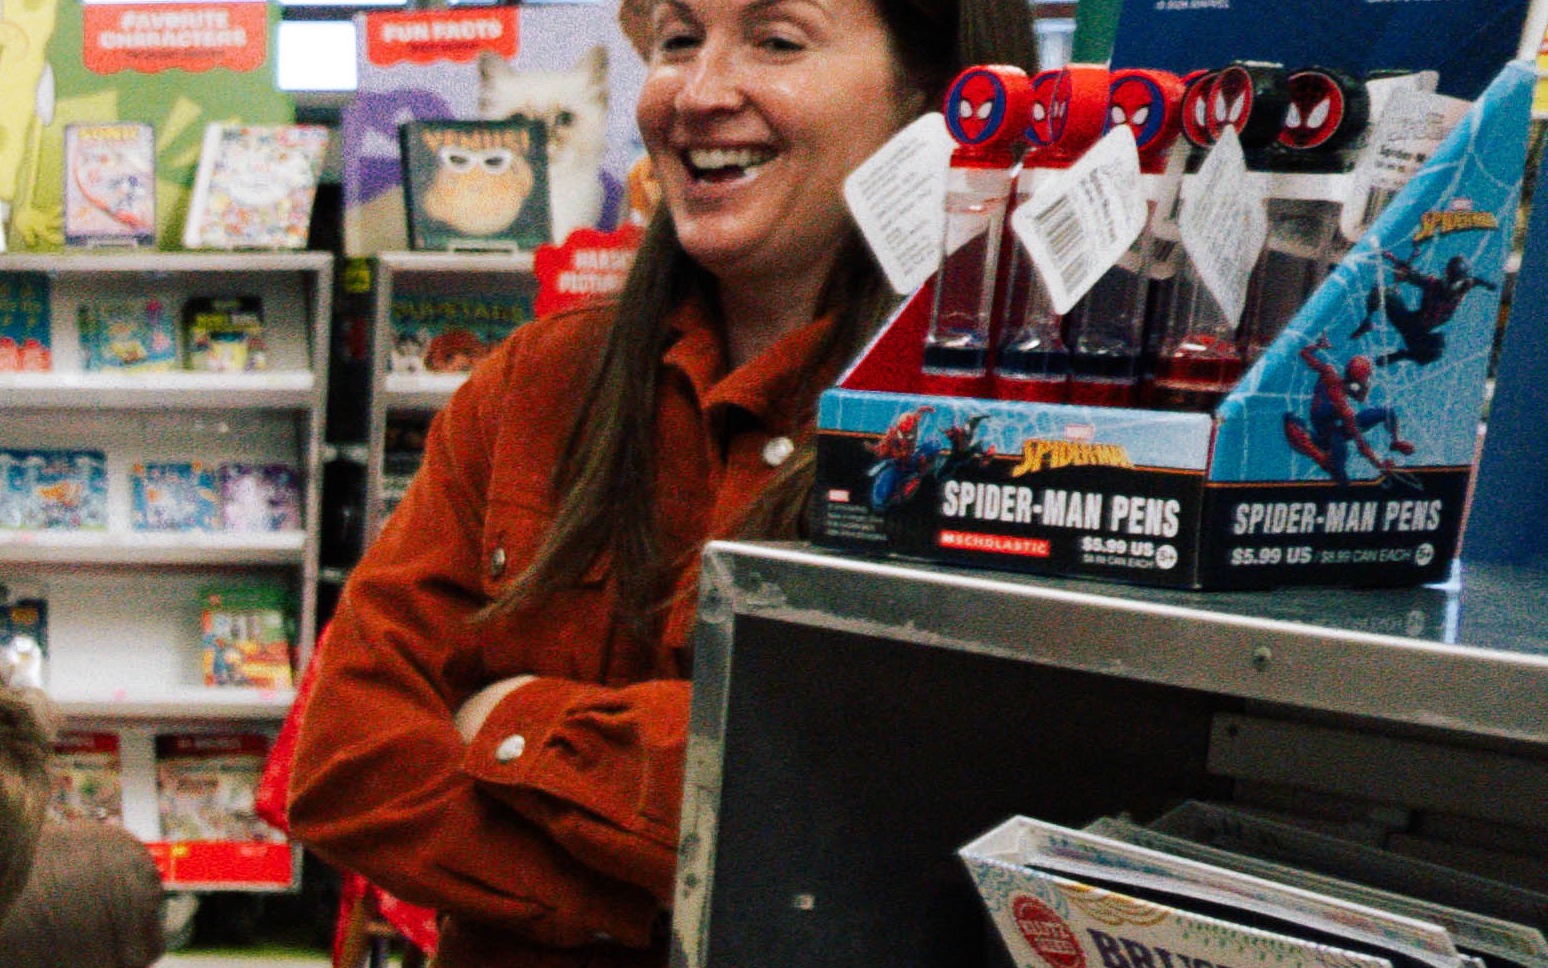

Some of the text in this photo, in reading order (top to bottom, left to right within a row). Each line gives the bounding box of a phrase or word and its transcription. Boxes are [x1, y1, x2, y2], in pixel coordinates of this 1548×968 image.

[942, 479, 1102, 531] SPIDER-MAN
[1109, 495, 1181, 539] PENS
[1231, 499, 1443, 536] SPIDER-MAN PENS
[956, 532, 1048, 555] SCHOLASTIC
[1130, 540, 1155, 556] US
[1231, 547, 1283, 566] $5.99
[1286, 546, 1313, 565] US
